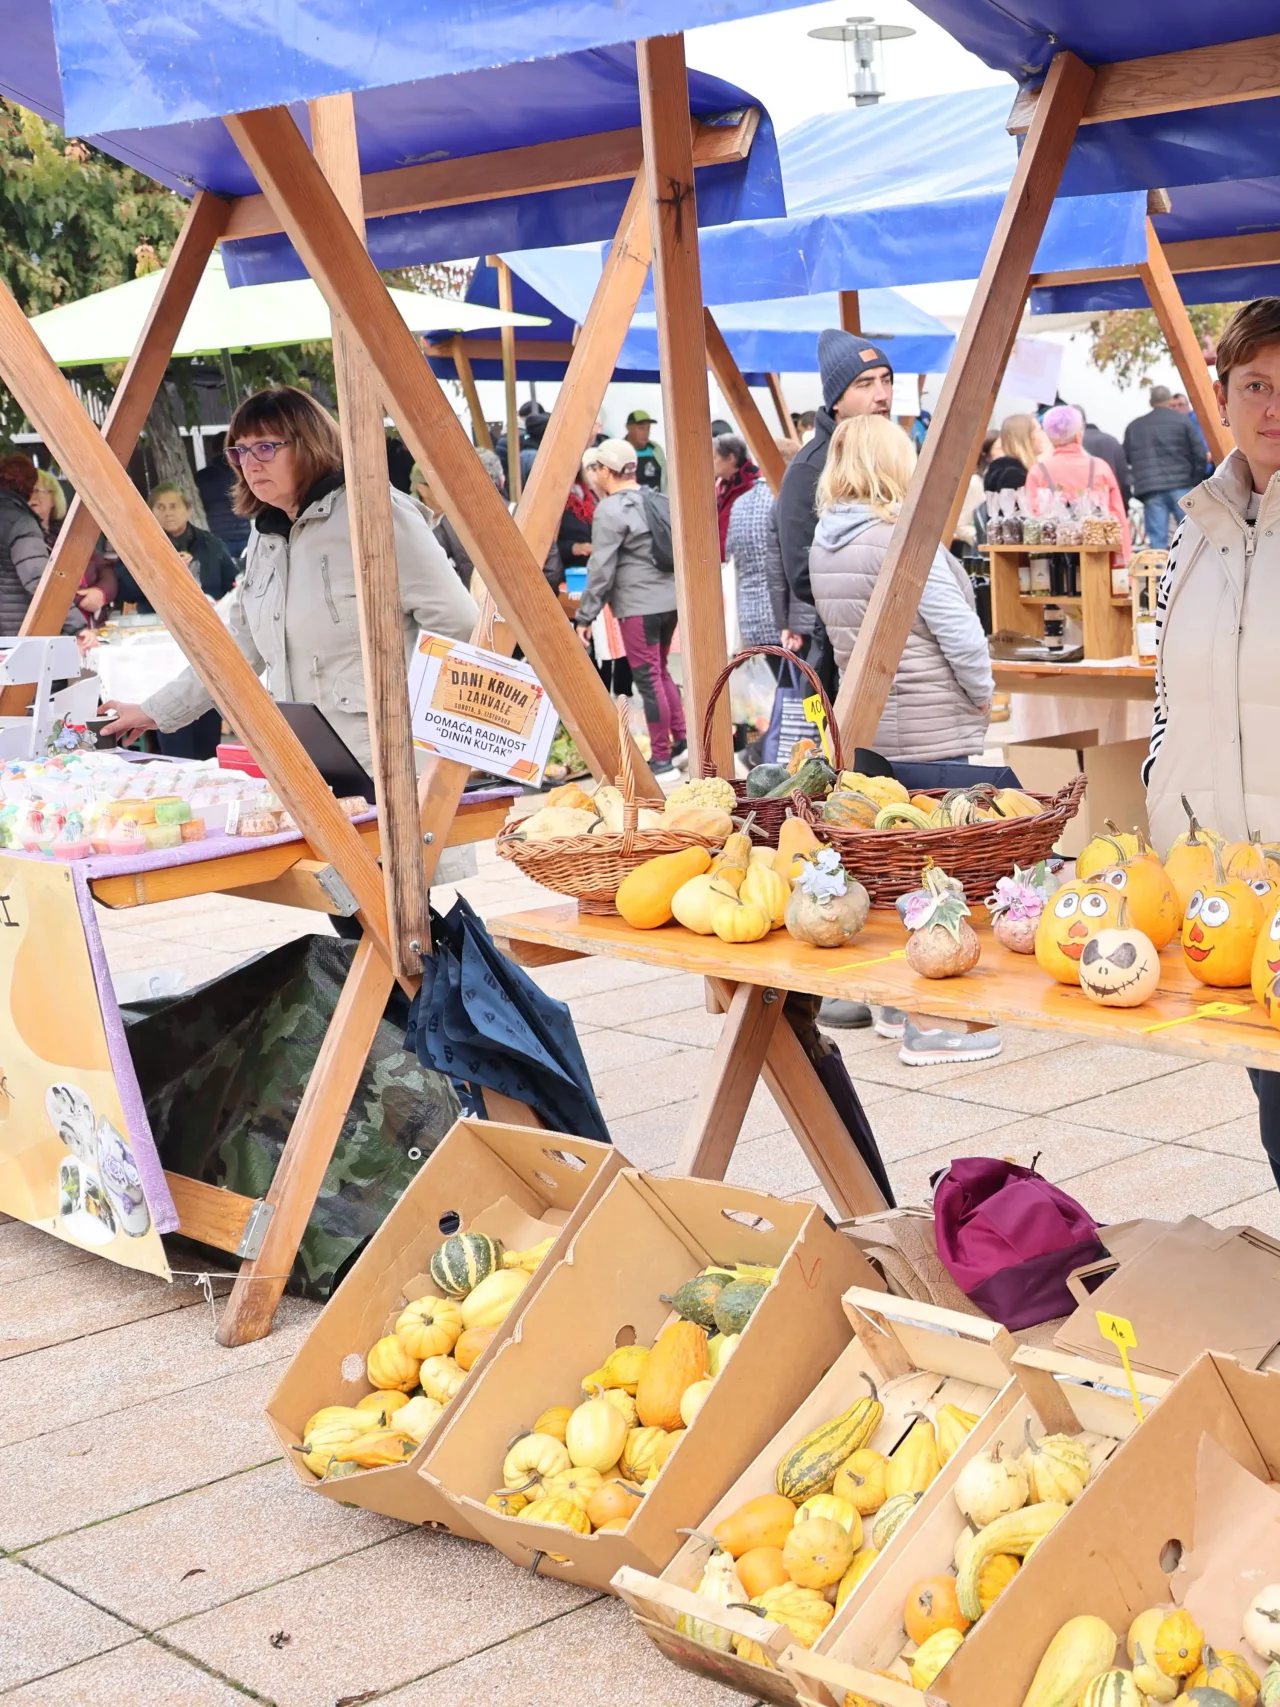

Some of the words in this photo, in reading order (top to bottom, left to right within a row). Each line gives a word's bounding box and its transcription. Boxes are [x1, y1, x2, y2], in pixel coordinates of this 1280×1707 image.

[452, 670, 483, 688] DANI
[488, 677, 528, 708] KRUHA
[459, 689, 462, 700] I
[467, 690, 512, 716] ZAHVALE
[811, 700, 821, 715] 10
[425, 712, 472, 734] DOMAĆA
[475, 728, 526, 751] RADINOST
